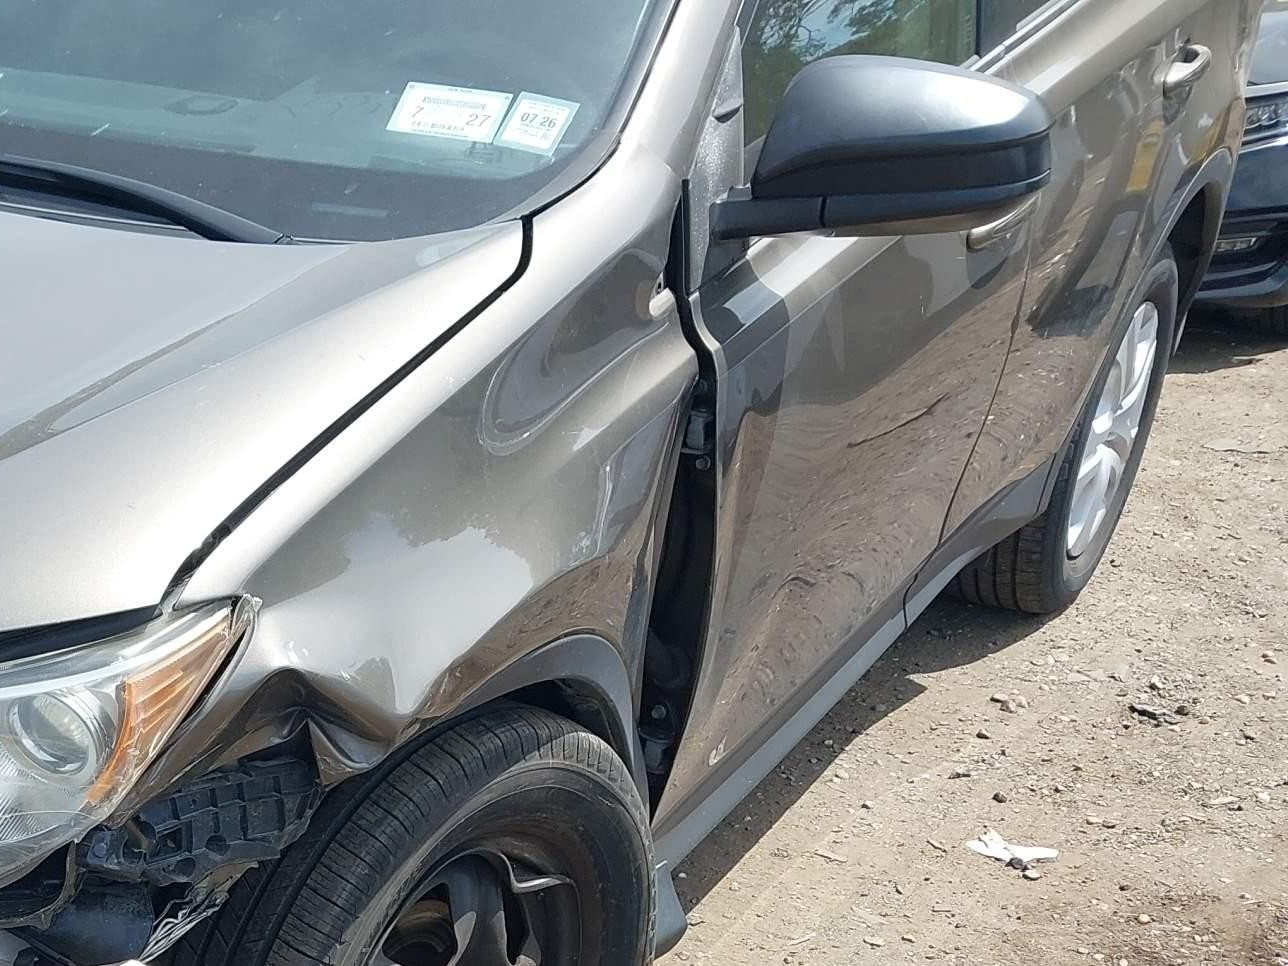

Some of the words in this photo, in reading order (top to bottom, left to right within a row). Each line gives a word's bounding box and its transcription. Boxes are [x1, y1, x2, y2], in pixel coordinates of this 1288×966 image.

[465, 113, 492, 127] 27
[520, 112, 538, 124] 07
[540, 116, 558, 129] 26
